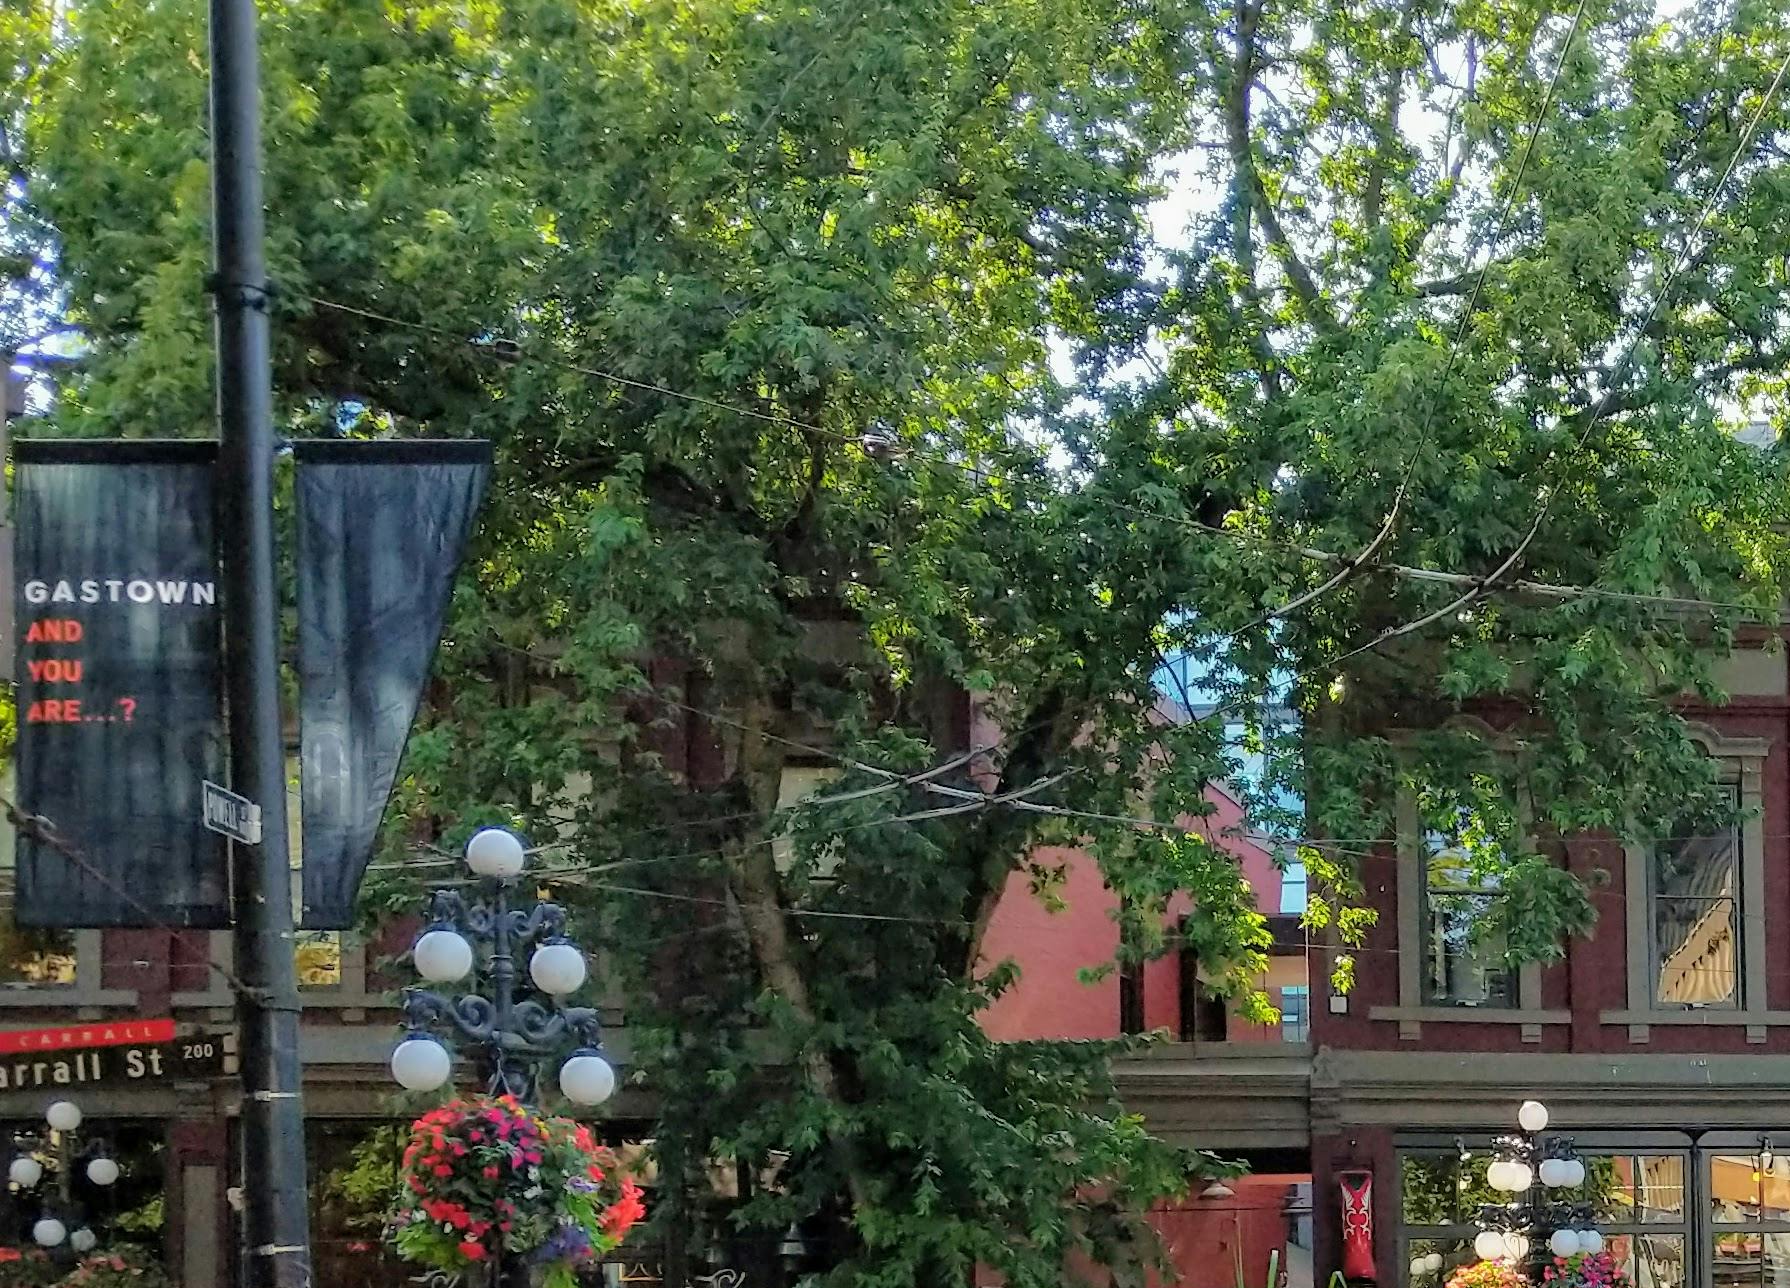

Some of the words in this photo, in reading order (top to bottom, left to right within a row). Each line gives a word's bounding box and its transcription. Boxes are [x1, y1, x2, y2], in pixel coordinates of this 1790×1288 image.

[24, 579, 216, 605] GASTOWN
[27, 619, 83, 643] AND
[28, 659, 83, 683] YOU
[19, 1027, 153, 1048] CARRALL
[126, 1048, 164, 1078] St
[183, 1043, 214, 1060] 200
